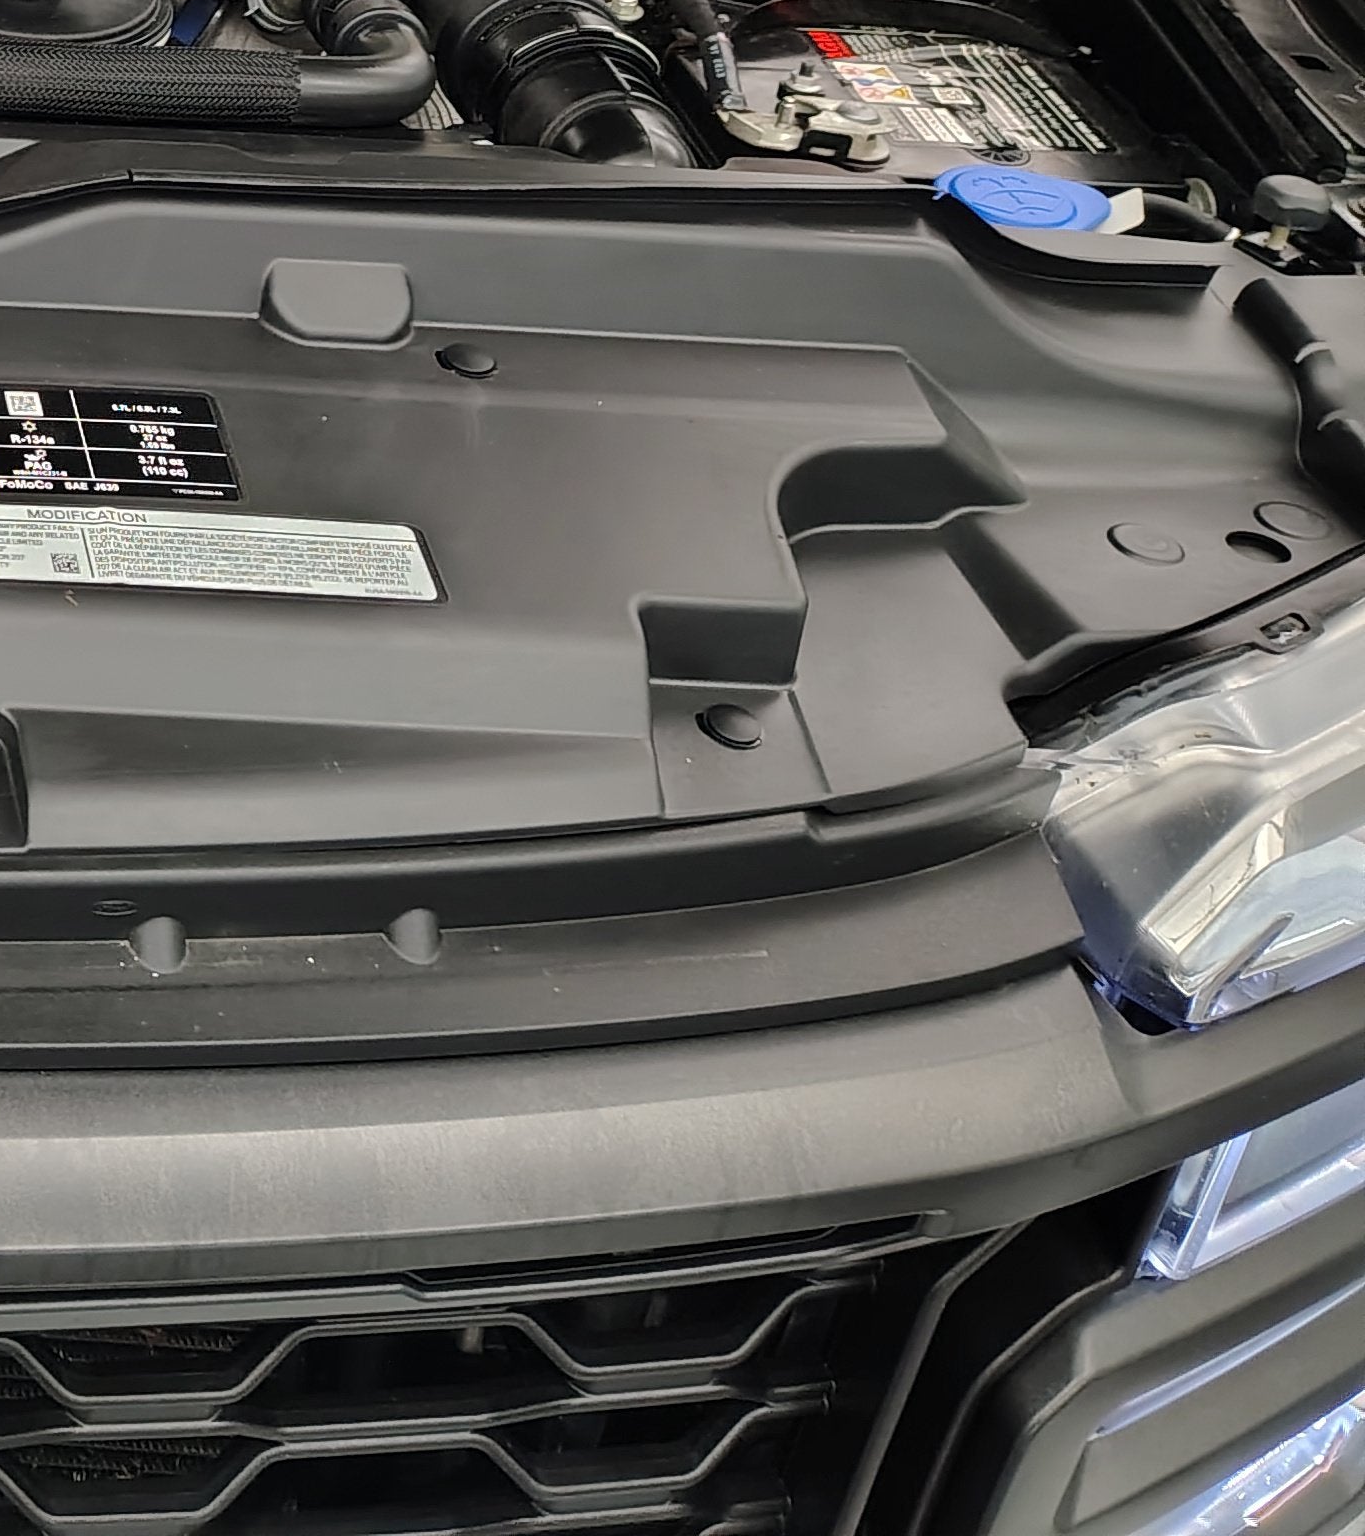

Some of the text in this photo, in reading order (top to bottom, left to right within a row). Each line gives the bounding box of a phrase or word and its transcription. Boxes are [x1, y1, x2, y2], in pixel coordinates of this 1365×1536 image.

[160, 425, 175, 437] kg
[9, 434, 56, 445] R-134a
[23, 461, 52, 471] PAG
[137, 455, 156, 465] 3.7
[168, 458, 184, 466] oz
[142, 466, 168, 477] (110
[26, 508, 148, 523] MODIFICATION
